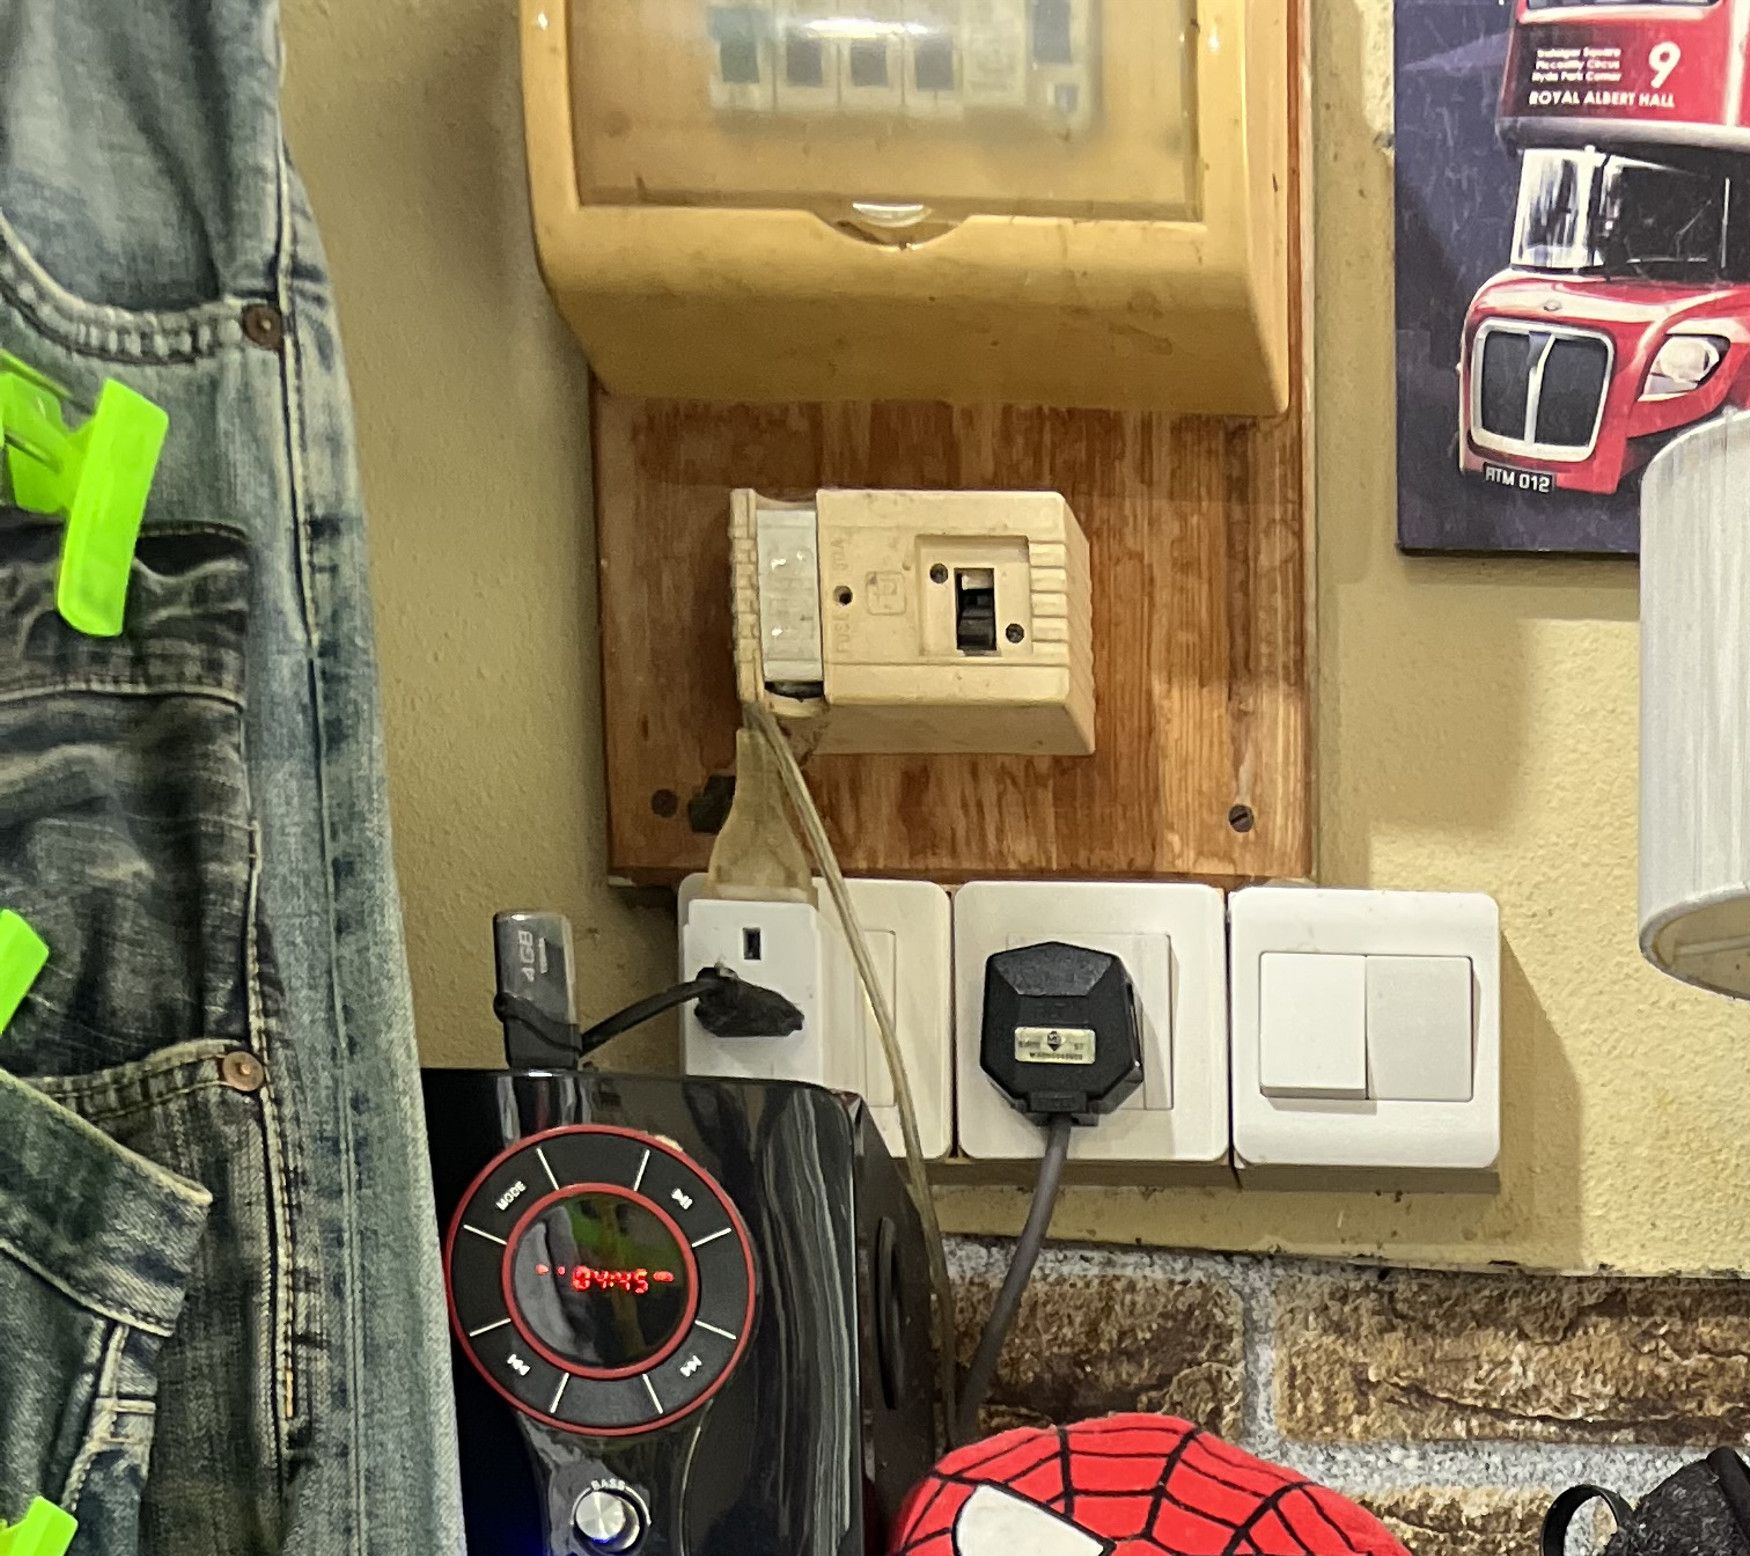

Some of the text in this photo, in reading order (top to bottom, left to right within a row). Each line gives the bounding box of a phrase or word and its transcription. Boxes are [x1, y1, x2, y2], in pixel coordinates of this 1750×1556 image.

[1648, 40, 1682, 89] 9
[1528, 90, 1676, 108] ROYAL ALBERT HALL
[1519, 473, 1551, 493] 012
[495, 1180, 528, 1212] MODE
[590, 1478, 626, 1491] BASS
